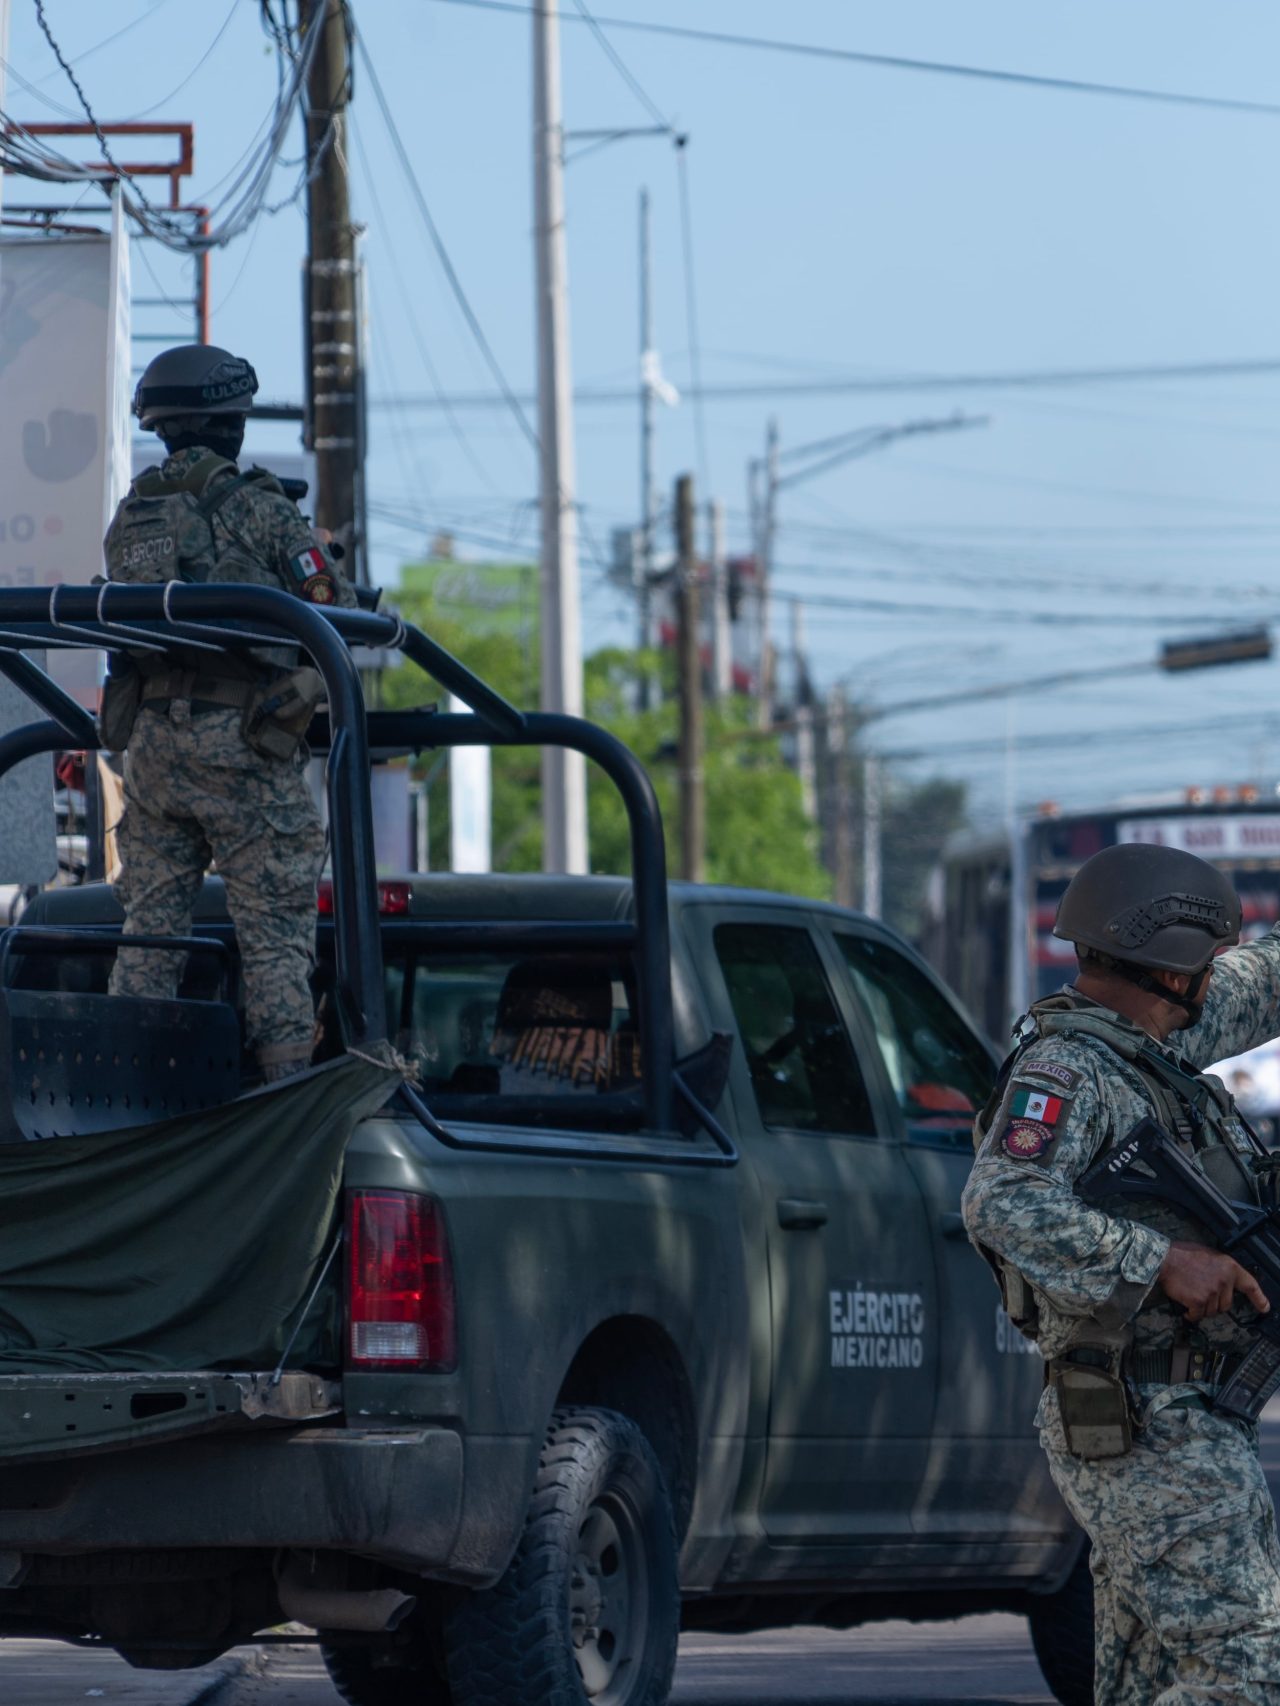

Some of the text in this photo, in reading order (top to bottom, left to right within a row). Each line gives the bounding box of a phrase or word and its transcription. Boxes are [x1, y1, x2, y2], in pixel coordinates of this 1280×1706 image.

[1027, 1062, 1073, 1082] MEXICO
[829, 1280, 925, 1335] EJÉRCITO
[831, 1337, 924, 1369] MEXICANO
